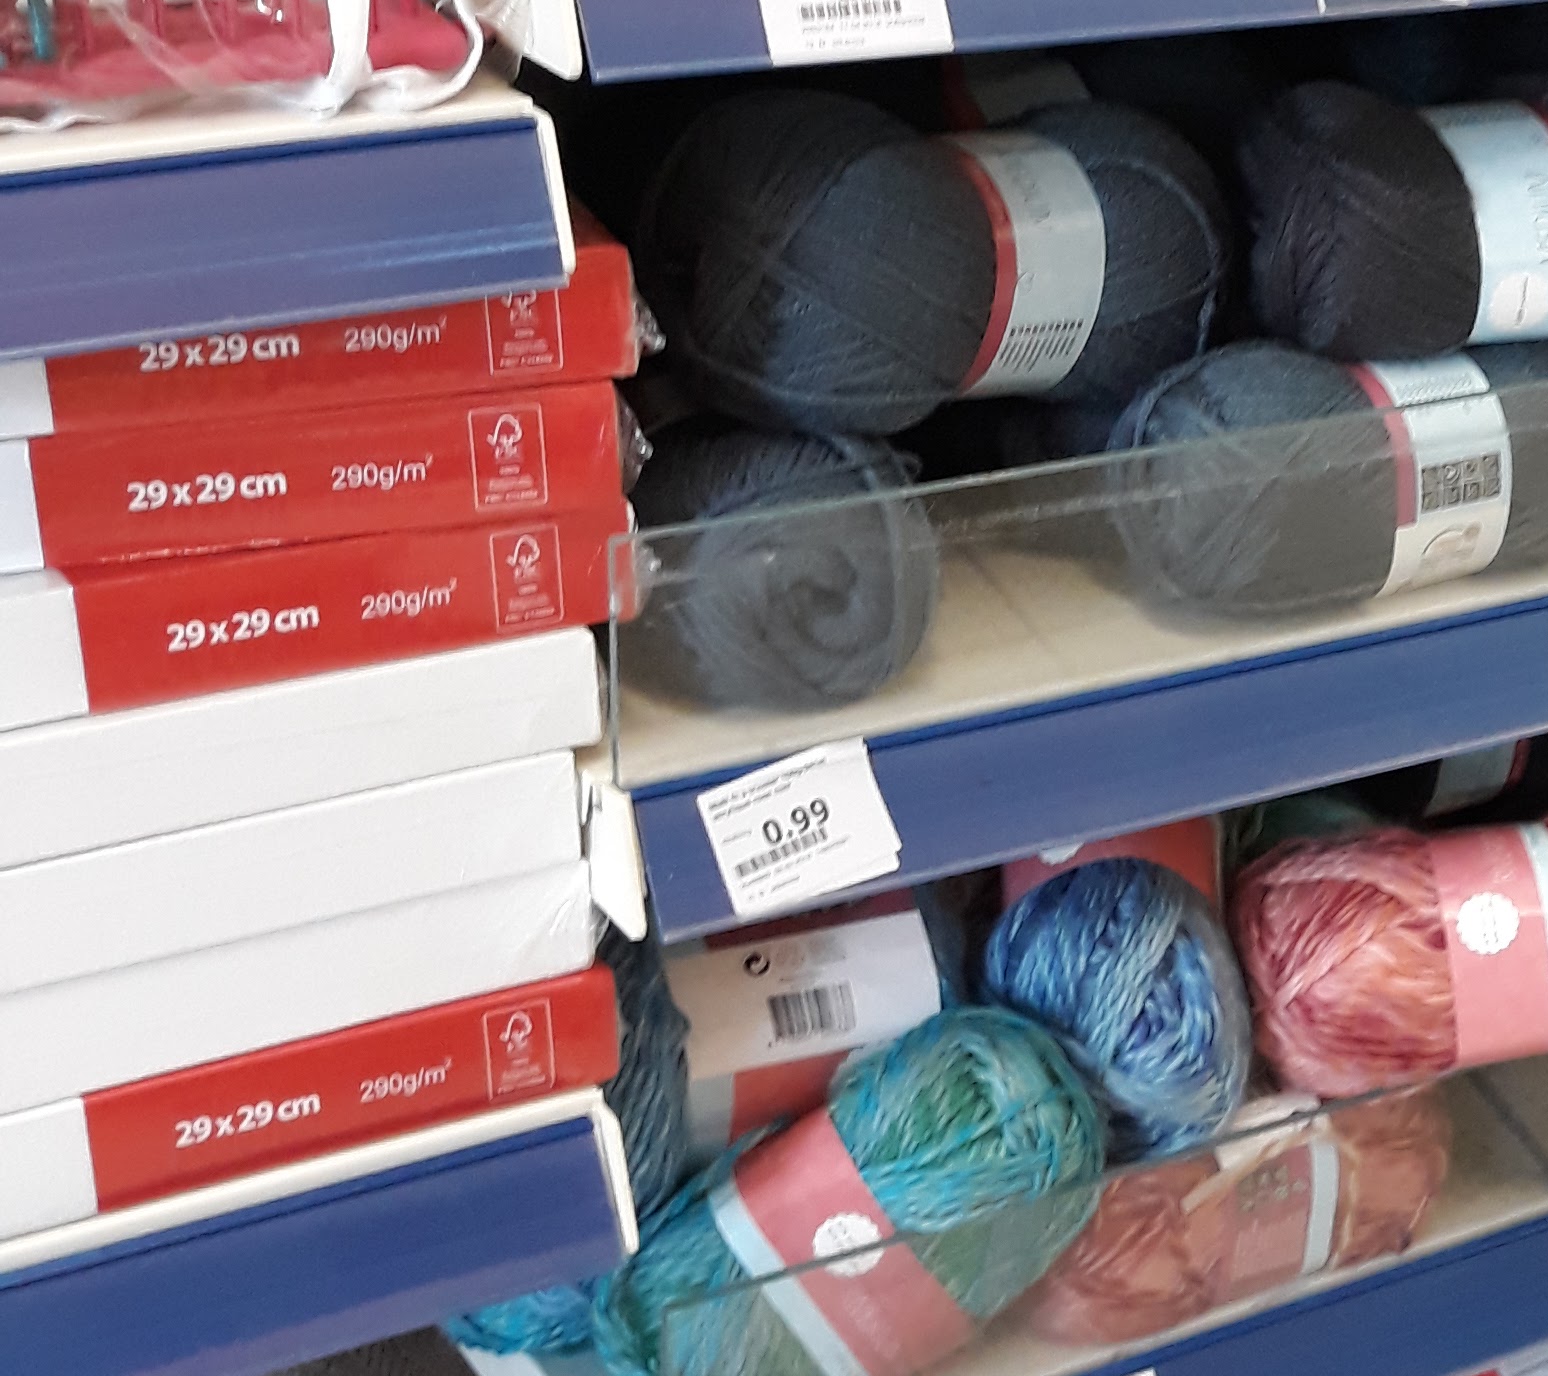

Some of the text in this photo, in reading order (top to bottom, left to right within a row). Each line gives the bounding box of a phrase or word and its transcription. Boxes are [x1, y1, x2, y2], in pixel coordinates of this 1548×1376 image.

[138, 334, 179, 373] 29
[208, 332, 249, 365] 29
[250, 332, 301, 363] cm
[126, 477, 168, 514] 29
[195, 472, 237, 504] 29
[239, 470, 289, 500] cm
[166, 616, 208, 654] 29
[232, 609, 272, 641] 29
[274, 604, 321, 635] cm
[761, 796, 831, 846] 0.99
[174, 1115, 213, 1150] 29
[236, 1099, 275, 1131] 29
[276, 1092, 323, 1122] cm
